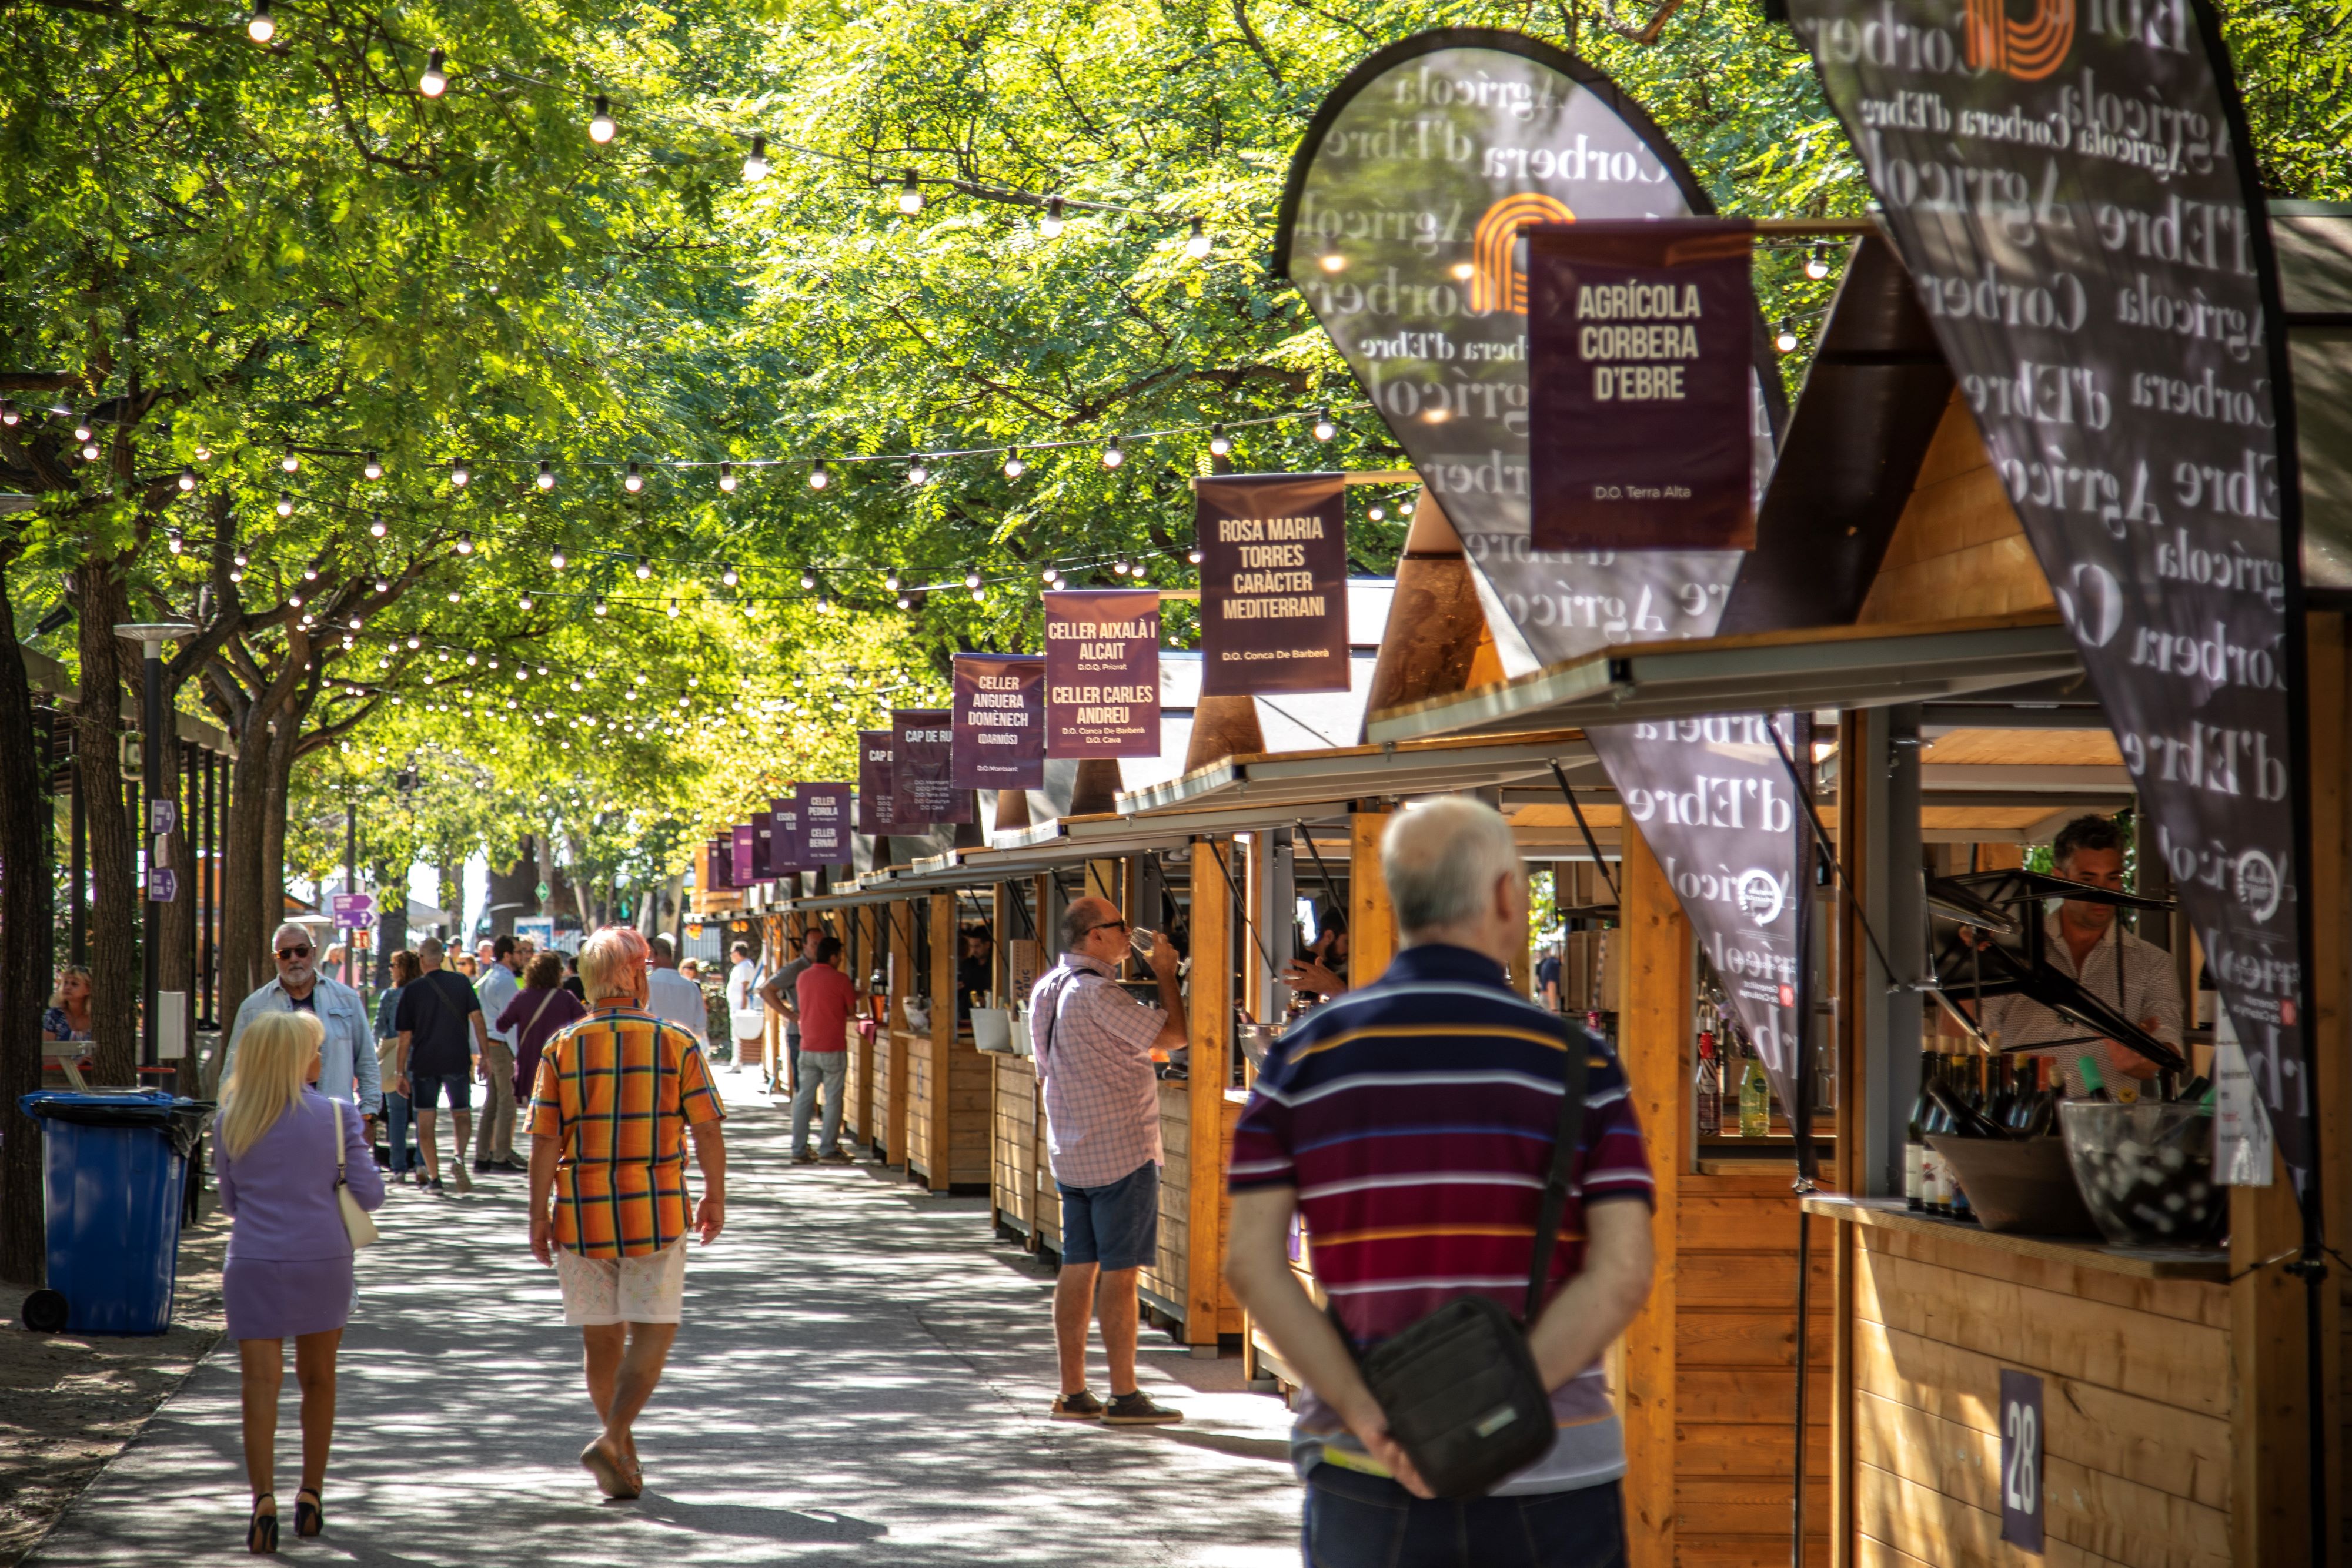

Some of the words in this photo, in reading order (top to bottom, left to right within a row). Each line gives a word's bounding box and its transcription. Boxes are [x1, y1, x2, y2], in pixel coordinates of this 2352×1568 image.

[1577, 278, 1702, 319] AGRÍCOLA
[1580, 325, 1699, 360] CORBERA
[1594, 366, 1686, 401] D'EBRE
[1595, 485, 1623, 499] D.O.
[1626, 485, 1661, 499] Terra
[1663, 485, 1692, 499] Alta
[1218, 519, 1265, 543] ROSA
[1267, 516, 1325, 541] MARIA
[1238, 544, 1305, 568] TORRES
[1232, 569, 1314, 594] CARÀCTER
[1222, 596, 1326, 620] MEDITERRANI
[1048, 622, 1097, 640] CELLER
[1099, 618, 1148, 639] AIXALÀ
[1150, 621, 1156, 638] I
[1079, 643, 1126, 660] ALCAIT
[1222, 652, 1242, 661] D.O.
[1244, 651, 1275, 660] Conca
[1277, 650, 1291, 659] De
[1292, 648, 1330, 658] Barberà
[978, 676, 1020, 690] CELLER
[973, 693, 1025, 708] ANGUERA
[1052, 687, 1101, 704] CELLER
[1102, 686, 1154, 703] CARLES
[968, 710, 1029, 727] DOMÈNECH
[1076, 707, 1130, 724] ANDREU
[905, 730, 924, 743] CAP
[925, 730, 938, 743] DE
[869, 750, 887, 762] CAP
[810, 796, 836, 806] CELLER
[808, 806, 838, 817] PEDROLA
[811, 828, 836, 838] CELLER
[2007, 1400, 2036, 1516] 28
